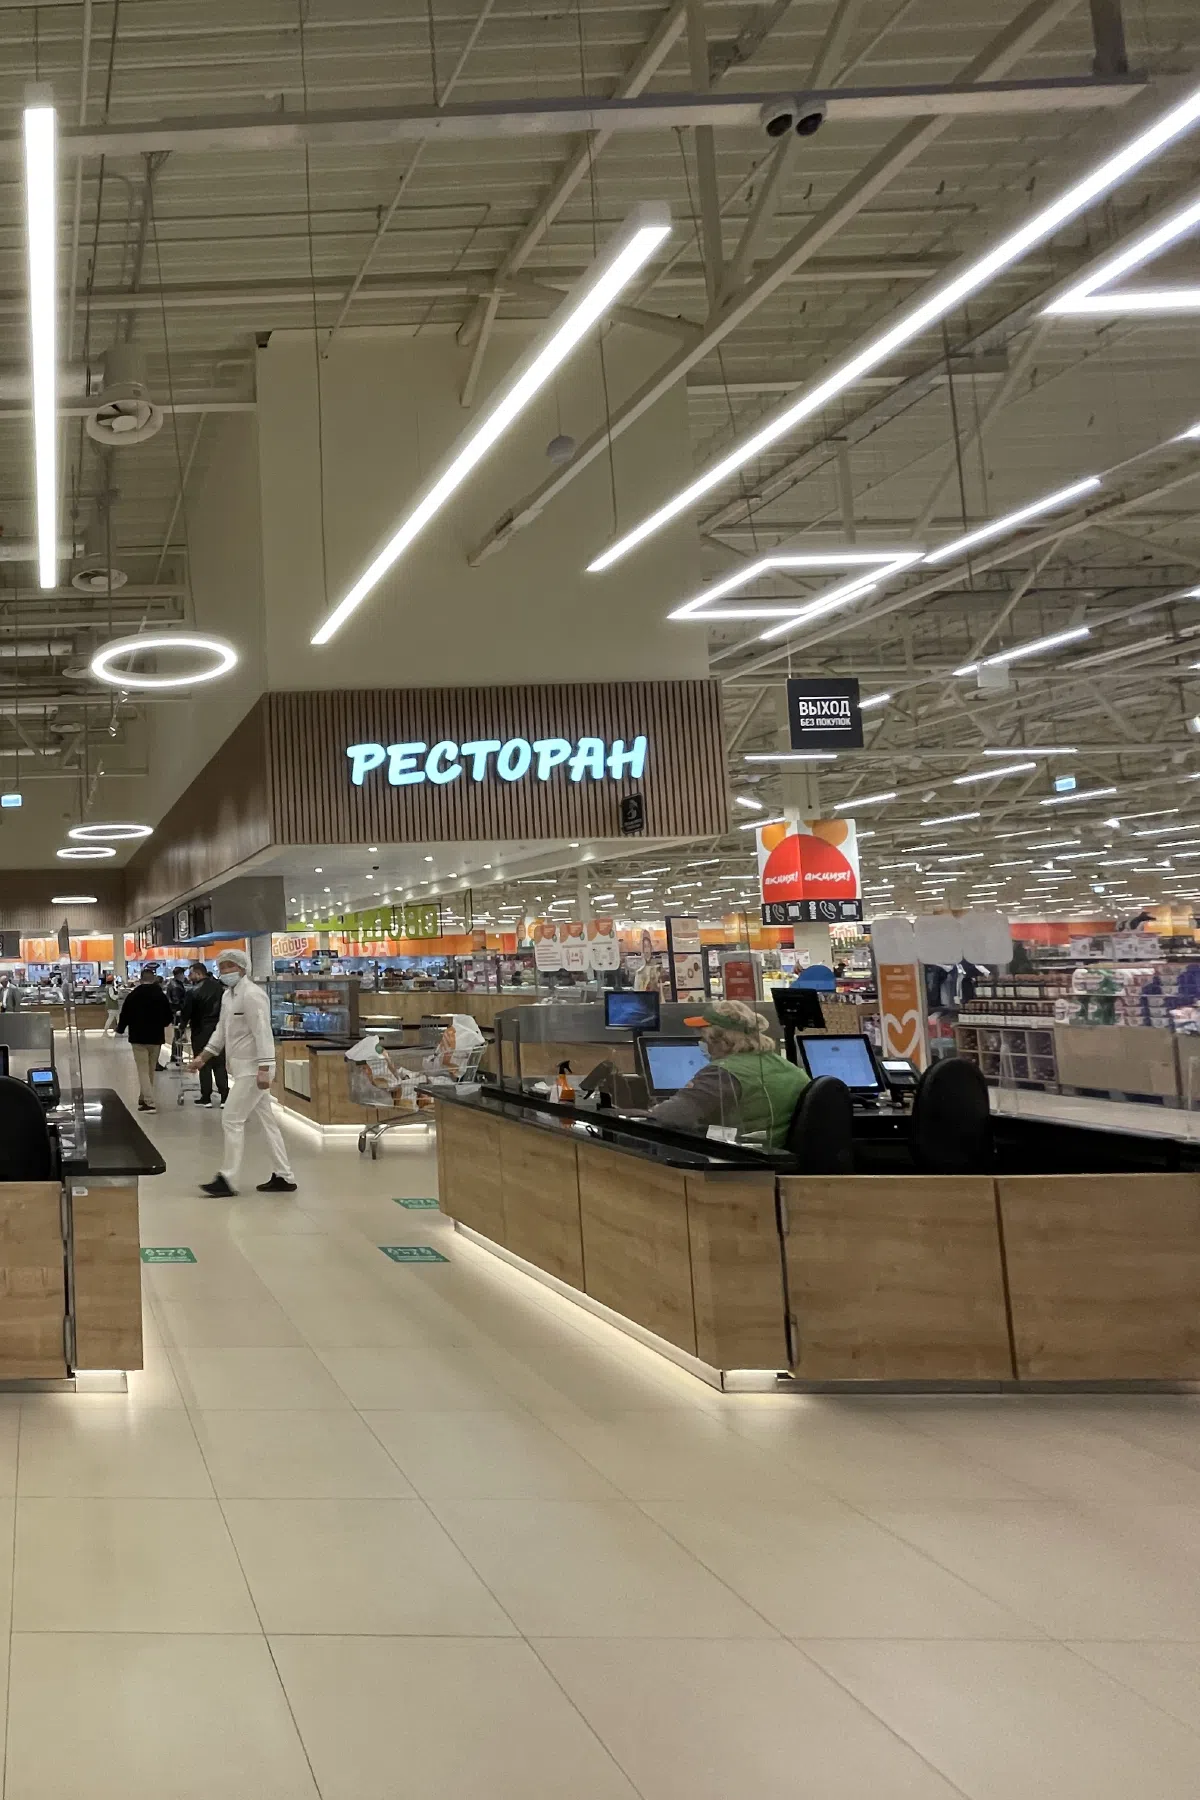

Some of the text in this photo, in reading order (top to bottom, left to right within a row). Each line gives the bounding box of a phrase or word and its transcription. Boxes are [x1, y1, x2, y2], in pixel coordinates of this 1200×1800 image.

[799, 700, 851, 717] ВЫХОД
[800, 717, 852, 727] БЕЗ ПОКУПОК
[347, 735, 648, 786] РЕСТОРАН
[804, 870, 852, 883] акция!
